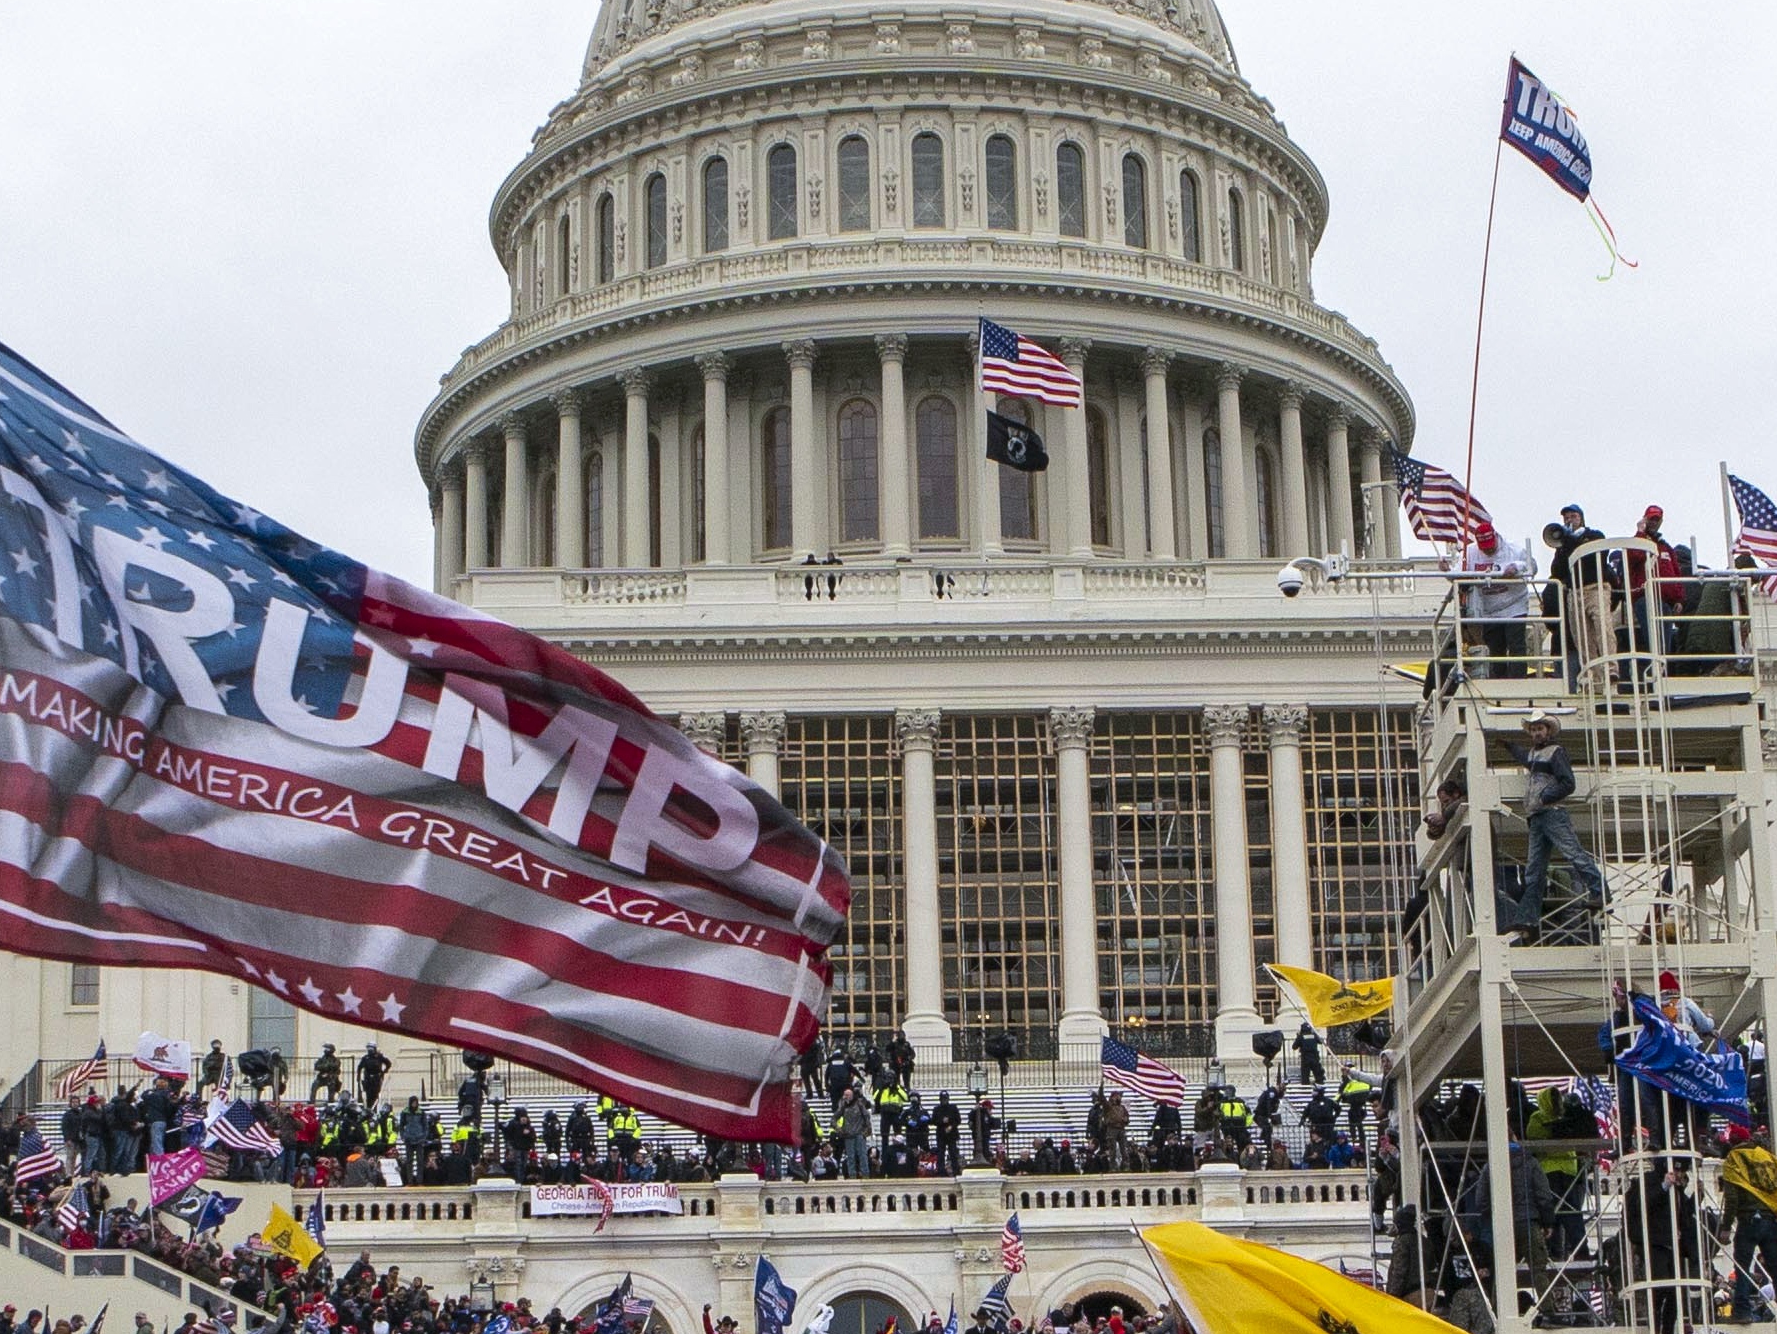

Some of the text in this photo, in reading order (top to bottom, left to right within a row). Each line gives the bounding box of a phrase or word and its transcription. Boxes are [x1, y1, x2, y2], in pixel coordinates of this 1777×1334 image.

[1508, 118, 1533, 141] KEEP
[1534, 133, 1573, 168] AMERICA
[154, 740, 364, 831] AMERICA
[379, 809, 567, 893] GREAT
[576, 882, 768, 950] AGAIN!
[536, 1186, 585, 1201] GEORGIA
[588, 1186, 618, 1201] FIGT
[622, 1186, 643, 1199] FOR
